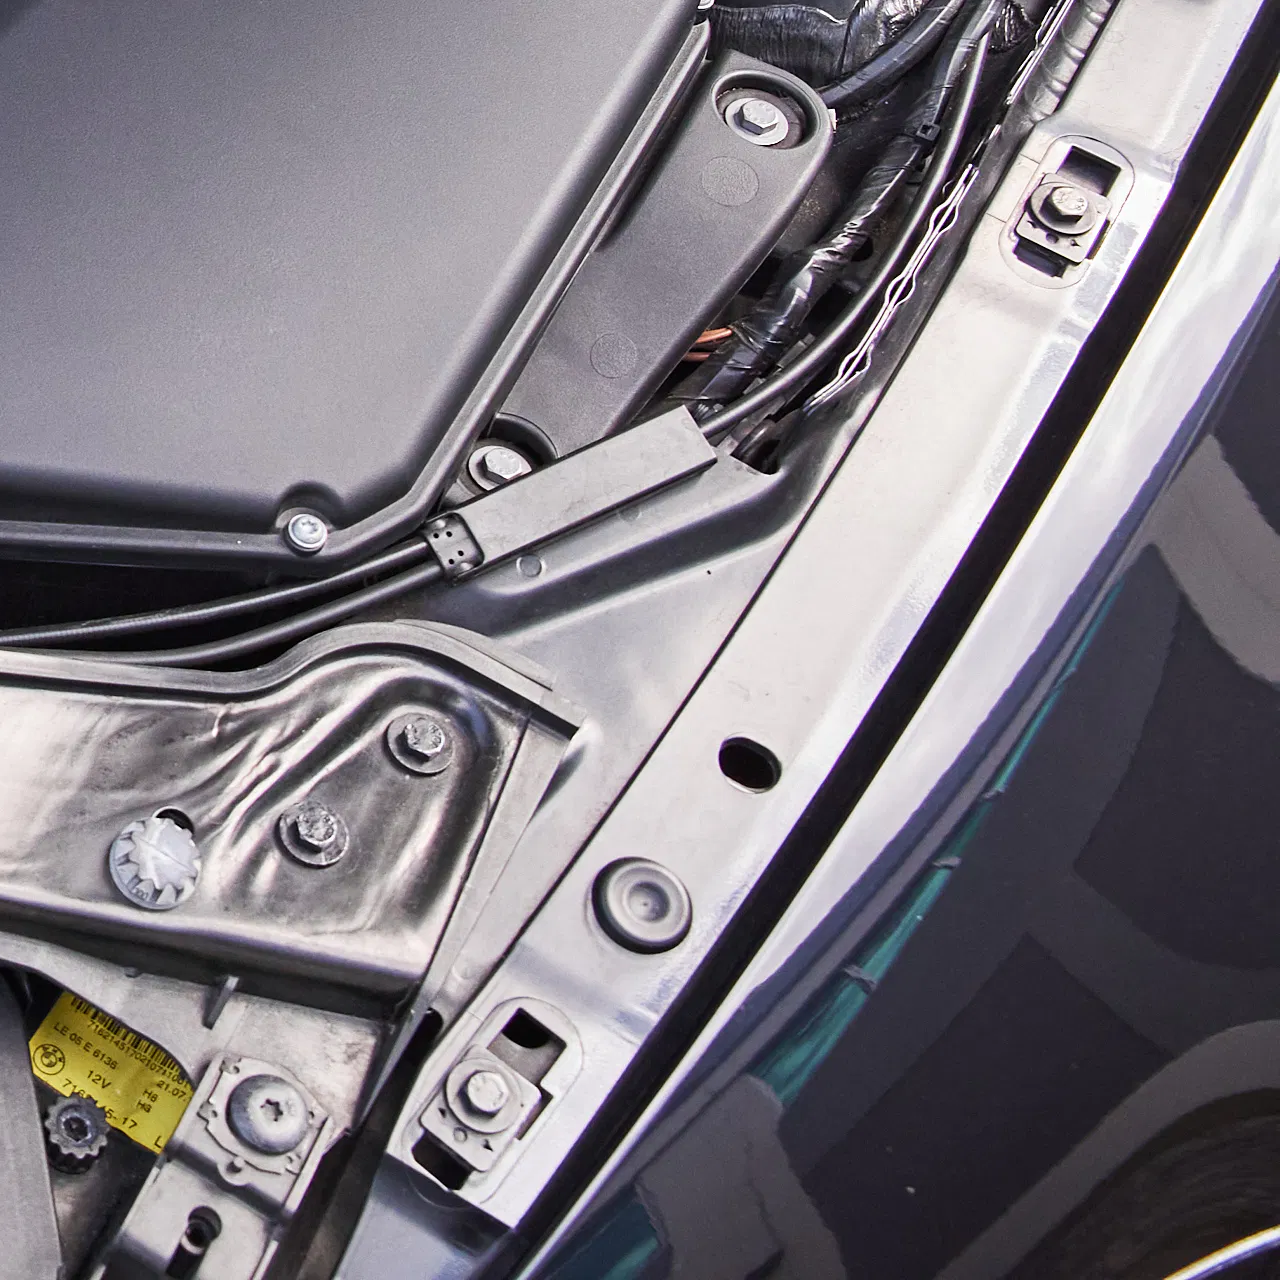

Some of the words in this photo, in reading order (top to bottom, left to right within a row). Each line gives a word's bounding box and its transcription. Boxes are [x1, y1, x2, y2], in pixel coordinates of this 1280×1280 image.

[53, 1022, 67, 1036] LE
[69, 1032, 83, 1046] 05
[83, 1042, 93, 1053] E
[87, 1070, 112, 1089] 12V
